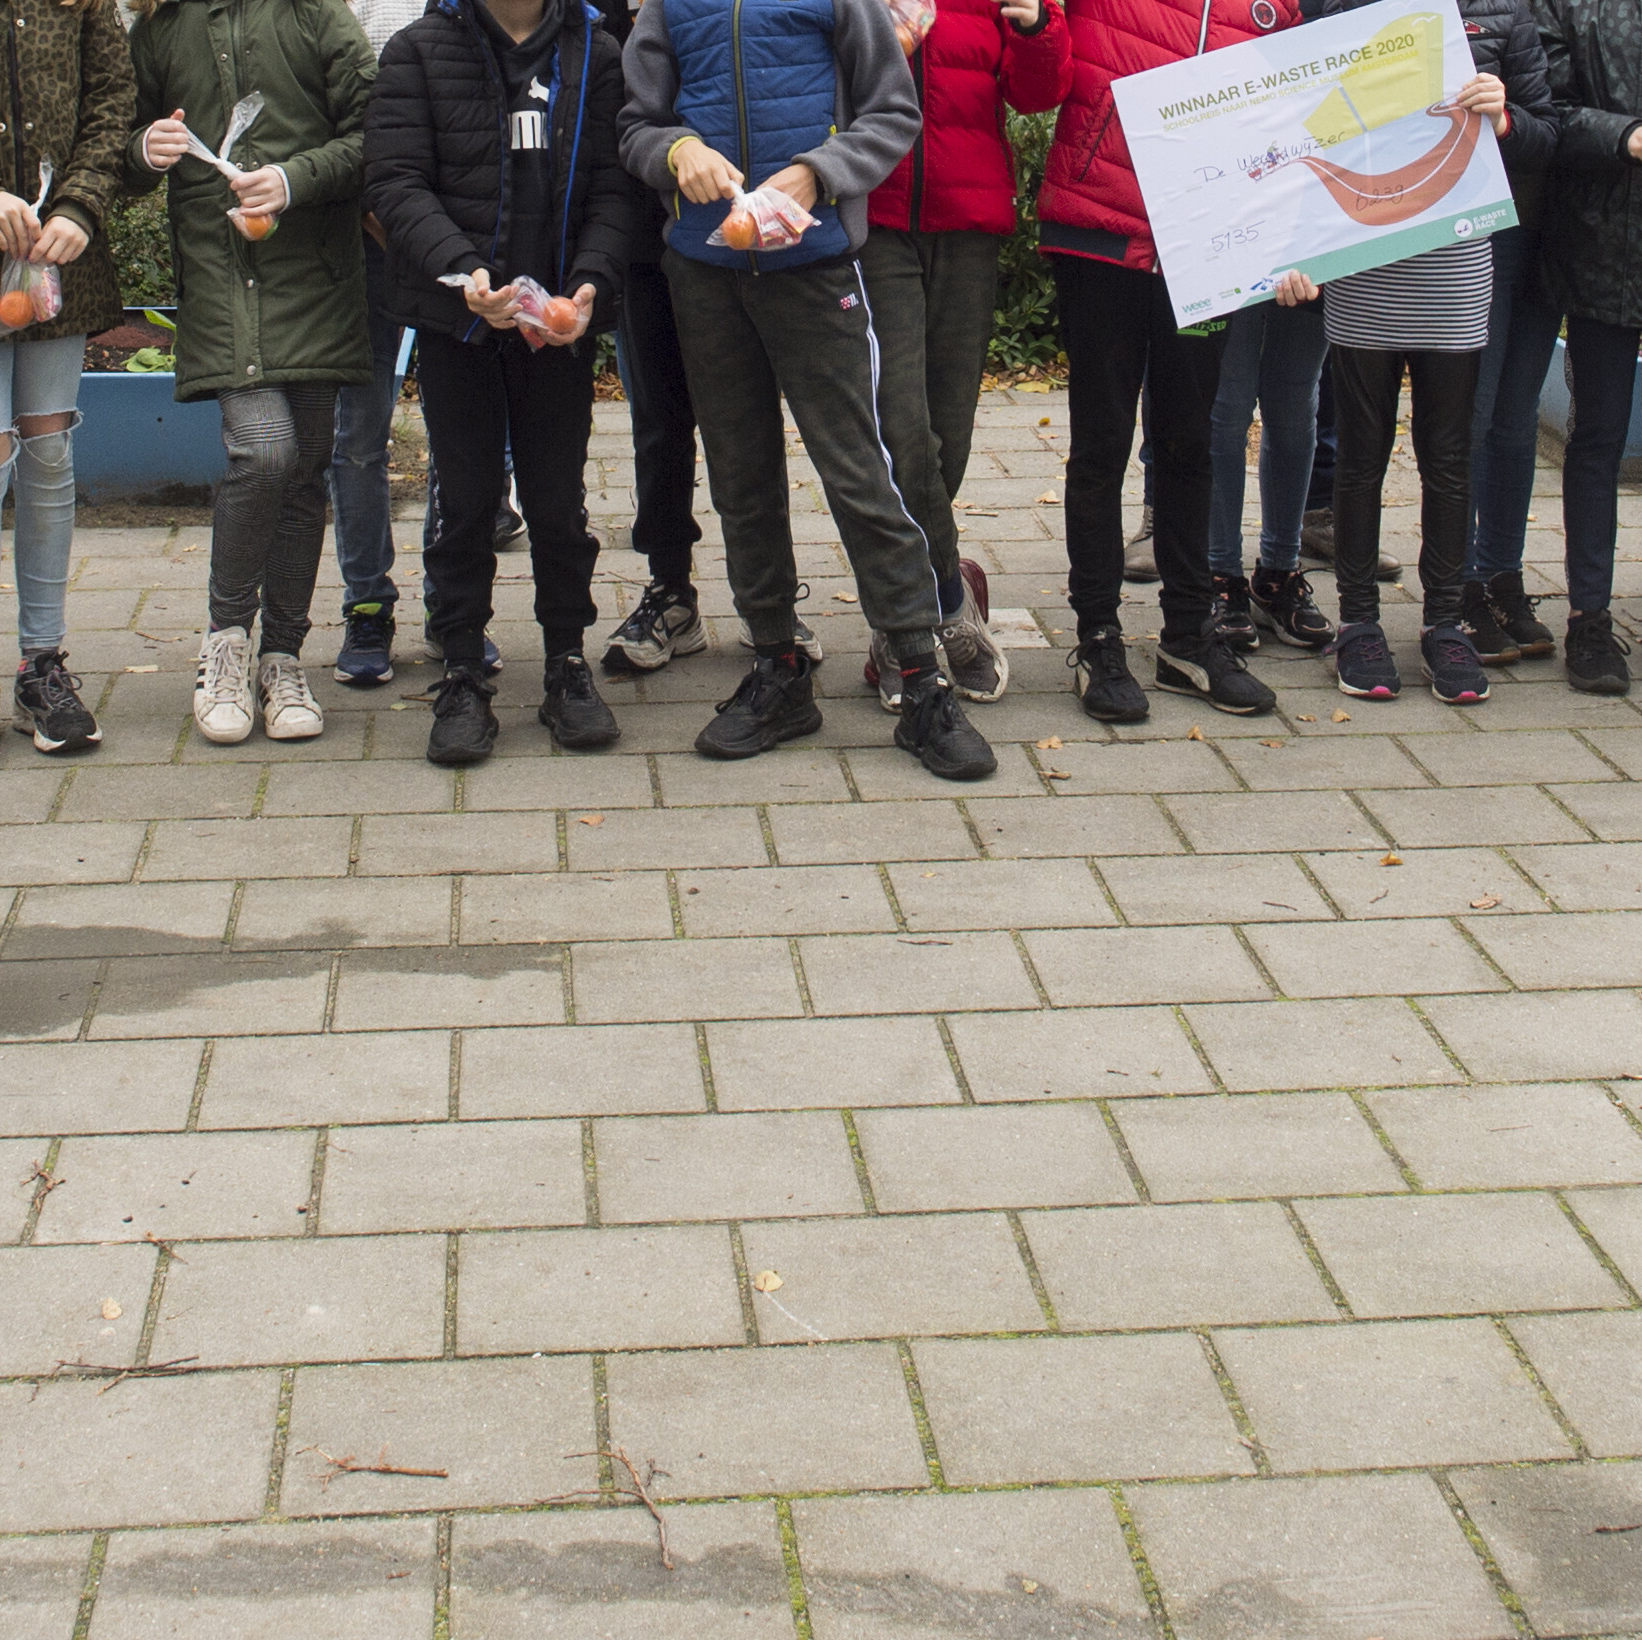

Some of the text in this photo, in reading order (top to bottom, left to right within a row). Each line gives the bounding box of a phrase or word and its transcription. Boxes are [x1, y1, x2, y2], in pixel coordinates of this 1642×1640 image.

[1158, 33, 1415, 120] WINNAAR E-WASTE RACE 2020
[1163, 50, 1419, 132] SCHOOLREIS NAAR NEMO SCIENCE MUSEUM AMSTERDAM
[1194, 166, 1226, 182] De
[1473, 209, 1507, 224] E-WASTE
[1474, 219, 1497, 232] RACE
[1211, 219, 1266, 252] 5135
[1182, 298, 1213, 314] weee
